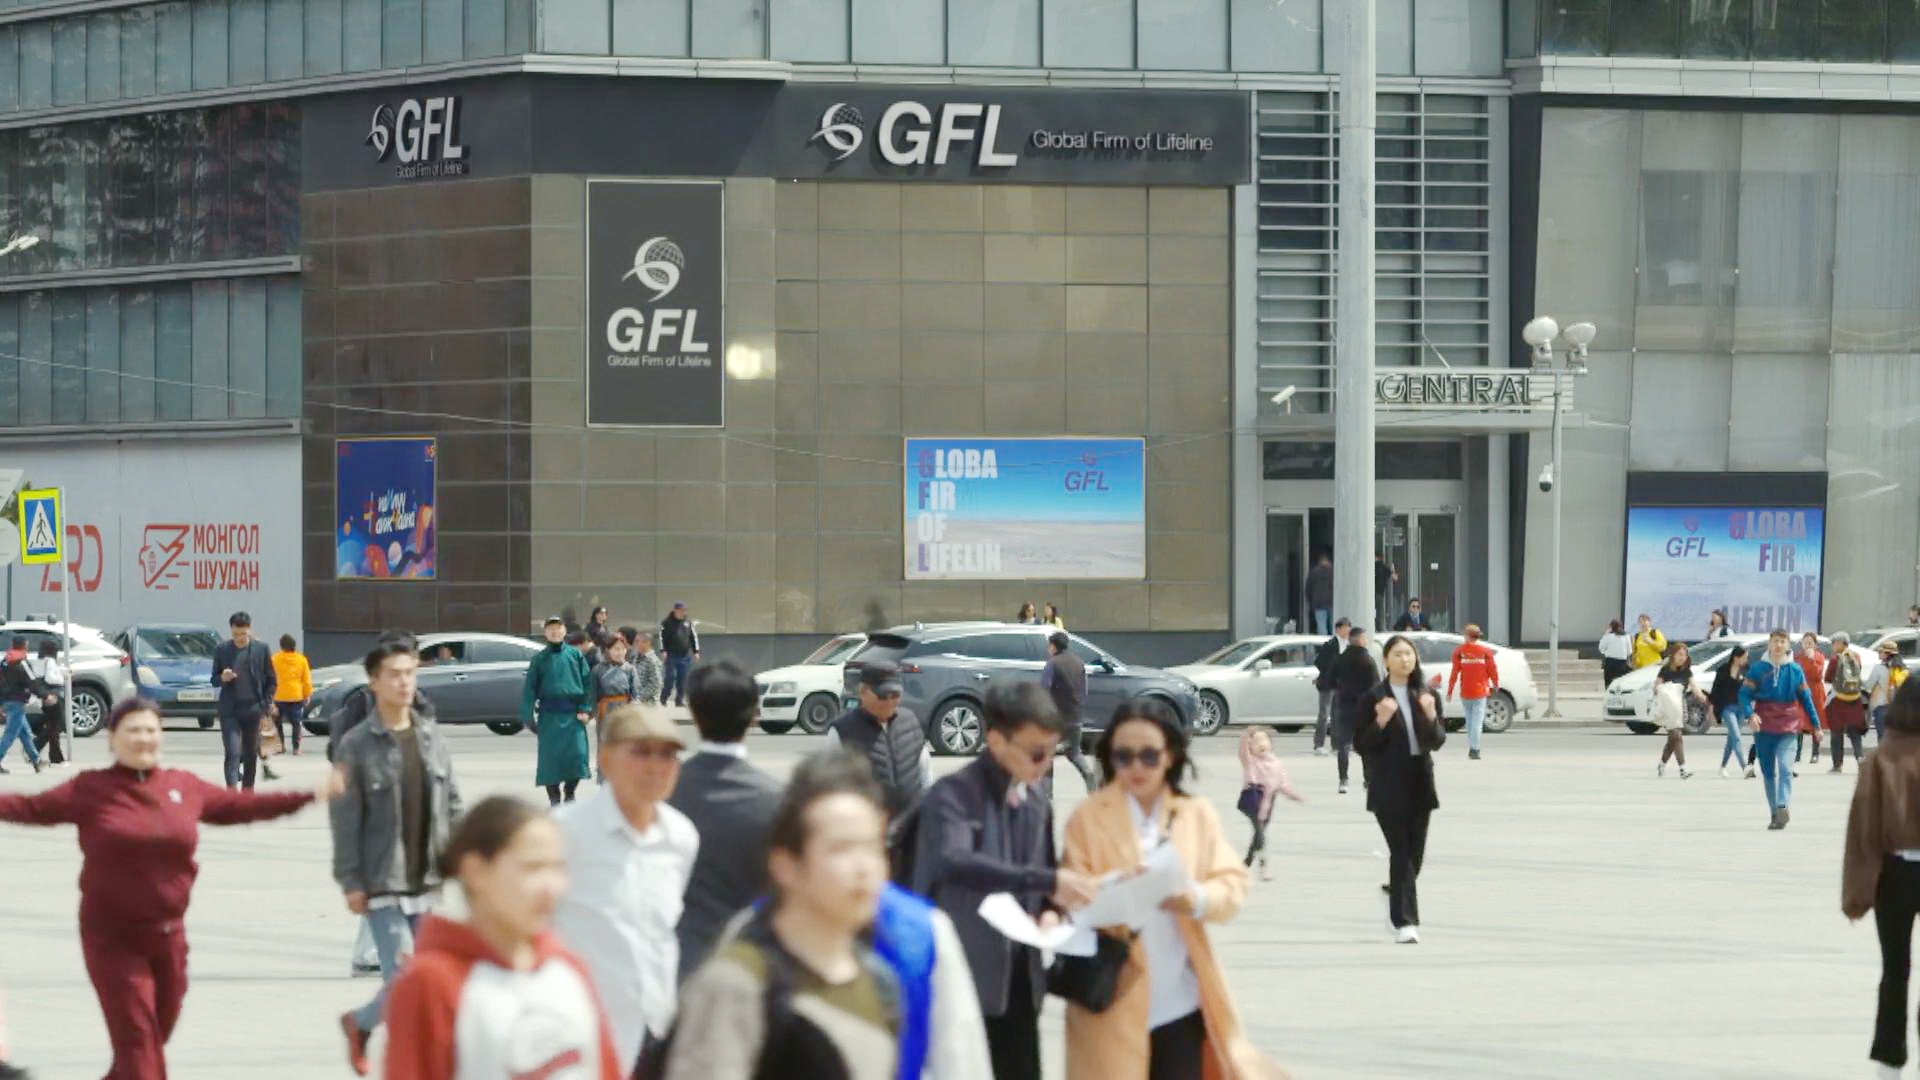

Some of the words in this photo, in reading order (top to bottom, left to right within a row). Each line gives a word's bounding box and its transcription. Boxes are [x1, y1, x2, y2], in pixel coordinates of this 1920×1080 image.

[396, 97, 463, 163] GFL
[878, 100, 1018, 166] GFL
[1032, 128, 1088, 149] Global
[1092, 130, 1130, 150] Firm
[1134, 132, 1152, 150] of
[1155, 132, 1214, 151] Lifeline
[606, 306, 710, 353] GFL
[607, 354, 640, 368] Global
[641, 354, 664, 368] Firm
[665, 355, 676, 368] of
[1379, 373, 1541, 403] CENTRAL
[1064, 470, 1109, 492] GFL
[193, 523, 260, 554] МОНГОЛ
[918, 512, 948, 542] OF
[1665, 536, 1710, 558] GFL
[193, 560, 260, 591] ШУУДАН
[1787, 574, 1816, 604] OF
